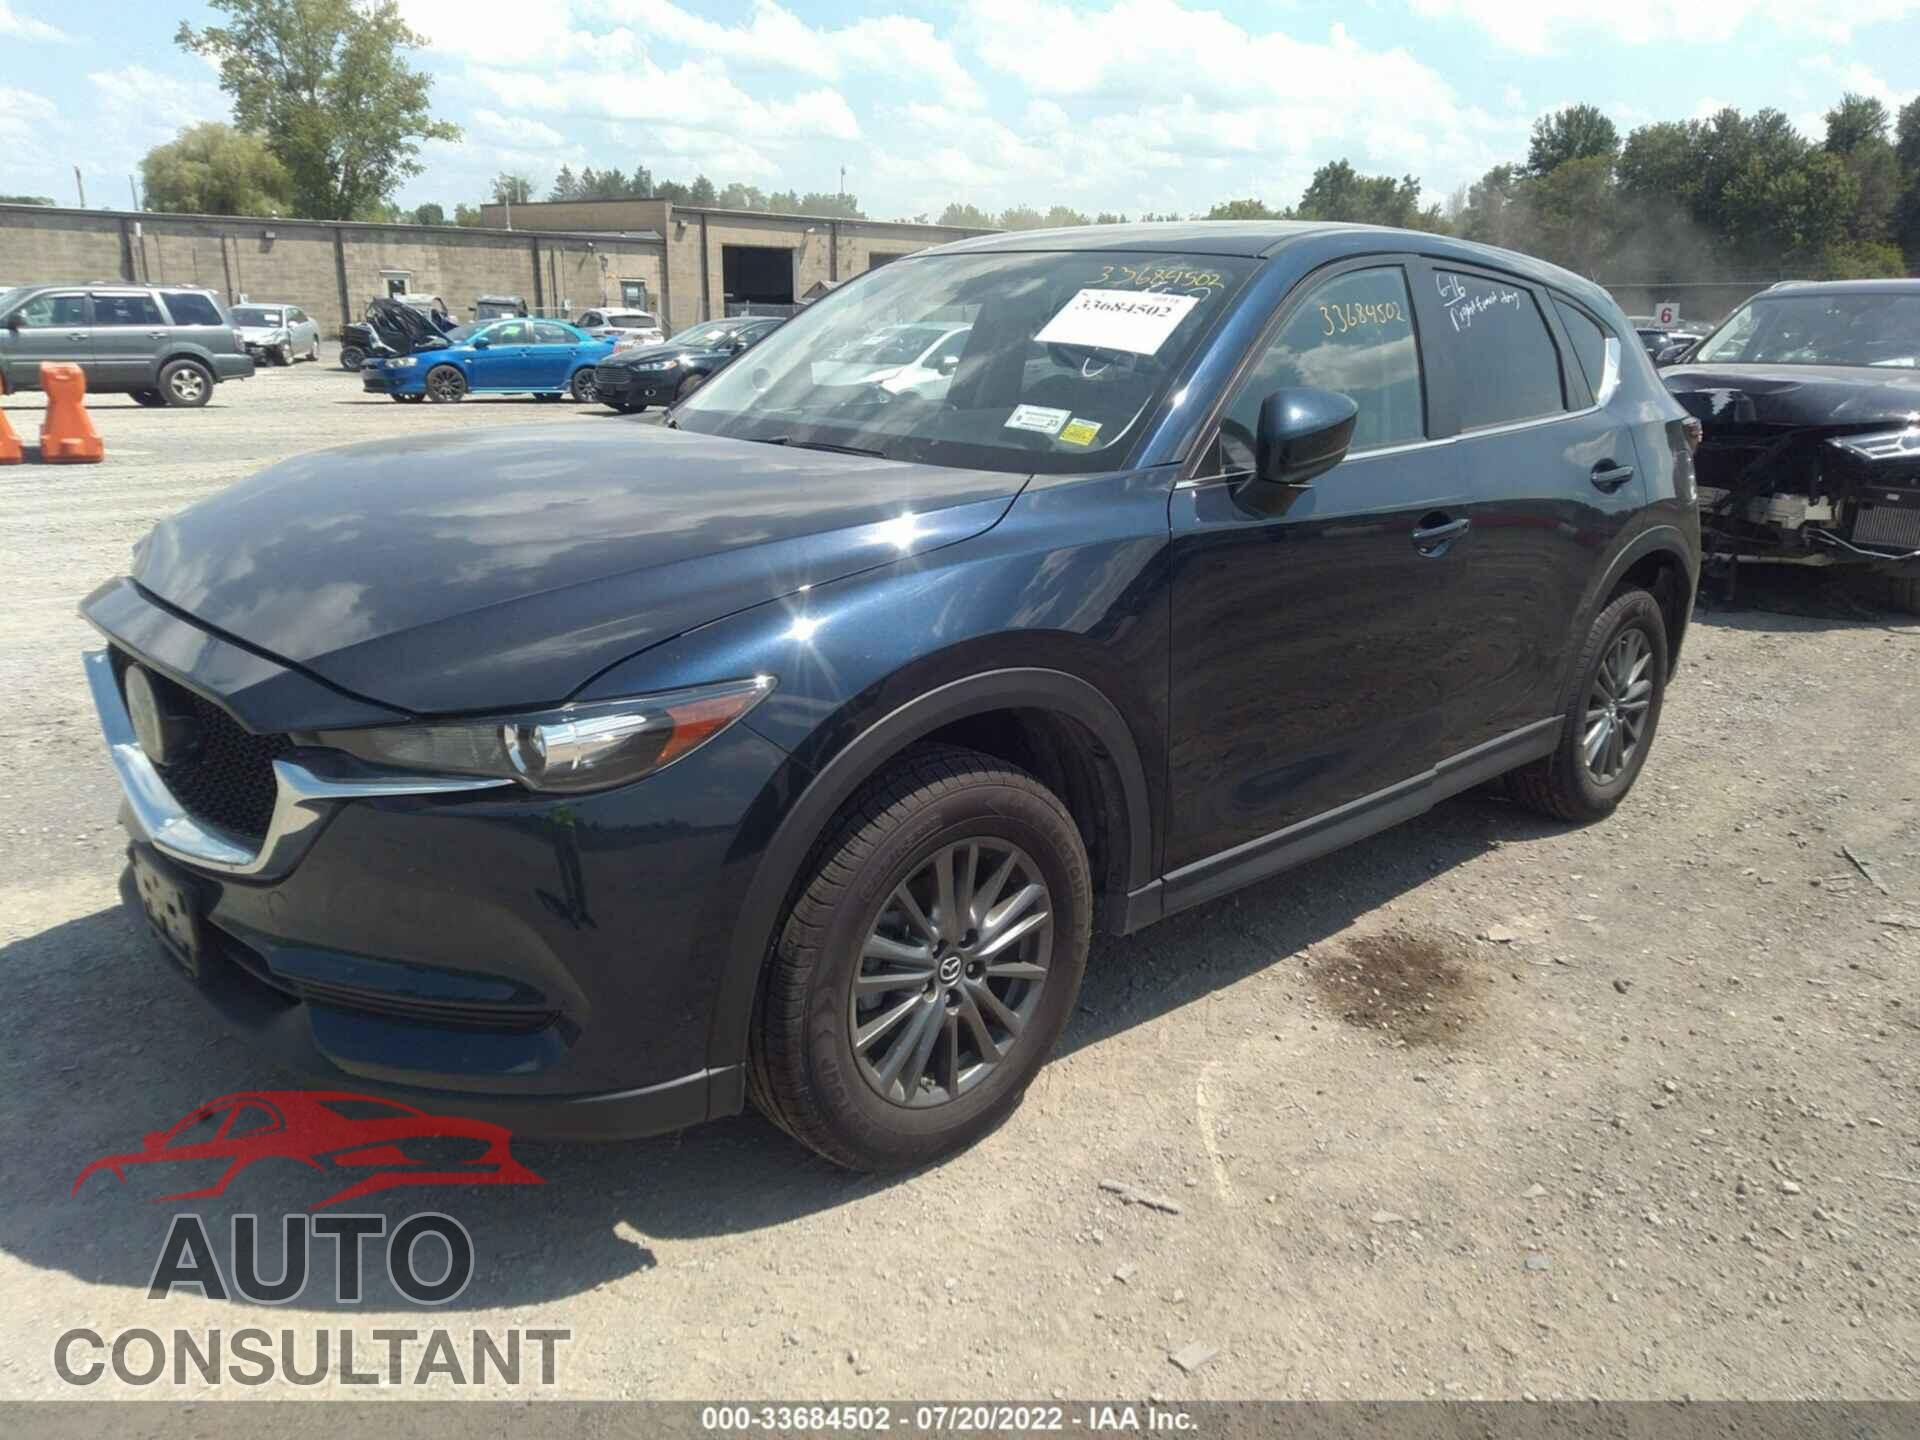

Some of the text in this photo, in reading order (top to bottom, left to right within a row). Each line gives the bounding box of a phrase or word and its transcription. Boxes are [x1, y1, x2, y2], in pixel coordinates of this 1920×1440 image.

[1075, 299, 1171, 318] 33684502
[1661, 307, 1672, 324] 6
[1319, 301, 1406, 337] 33684502
